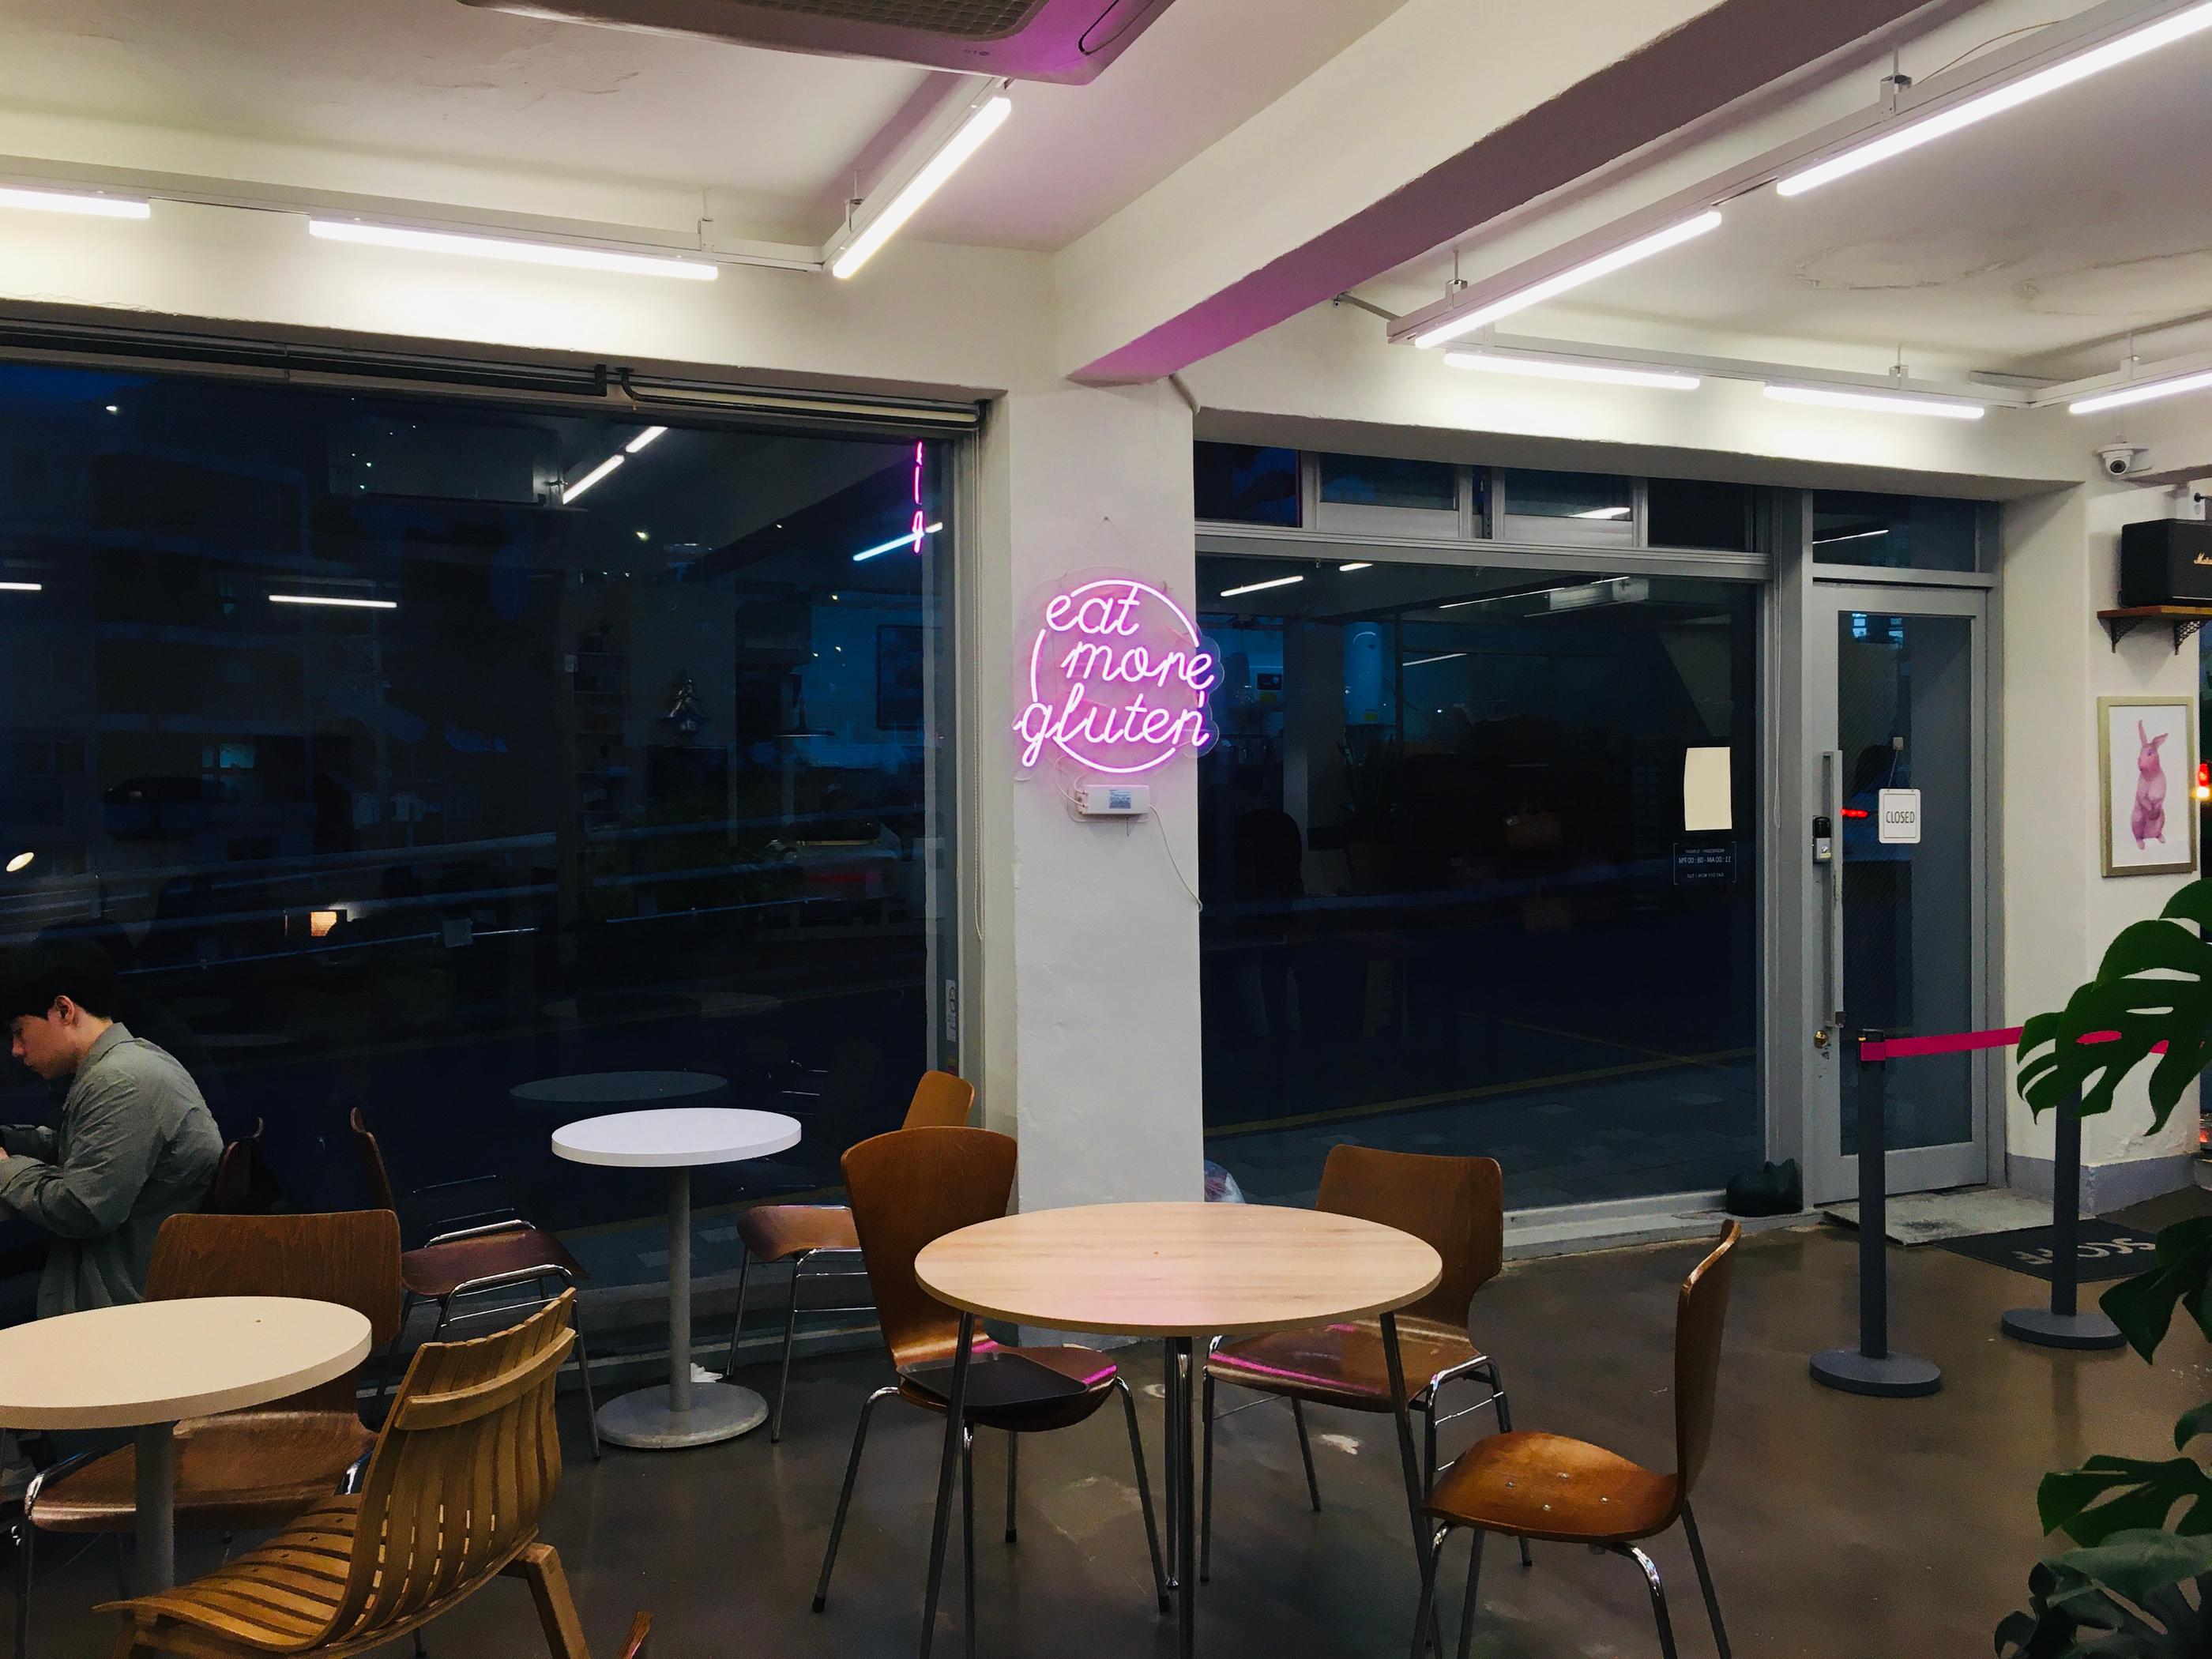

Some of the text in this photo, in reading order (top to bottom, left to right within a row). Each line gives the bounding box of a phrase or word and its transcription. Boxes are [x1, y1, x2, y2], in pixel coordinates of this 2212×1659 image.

[1045, 586, 1140, 636] eat
[1060, 641, 1215, 690] more
[1012, 682, 1210, 768] gluten
[1886, 811, 1915, 823] CLOSED
